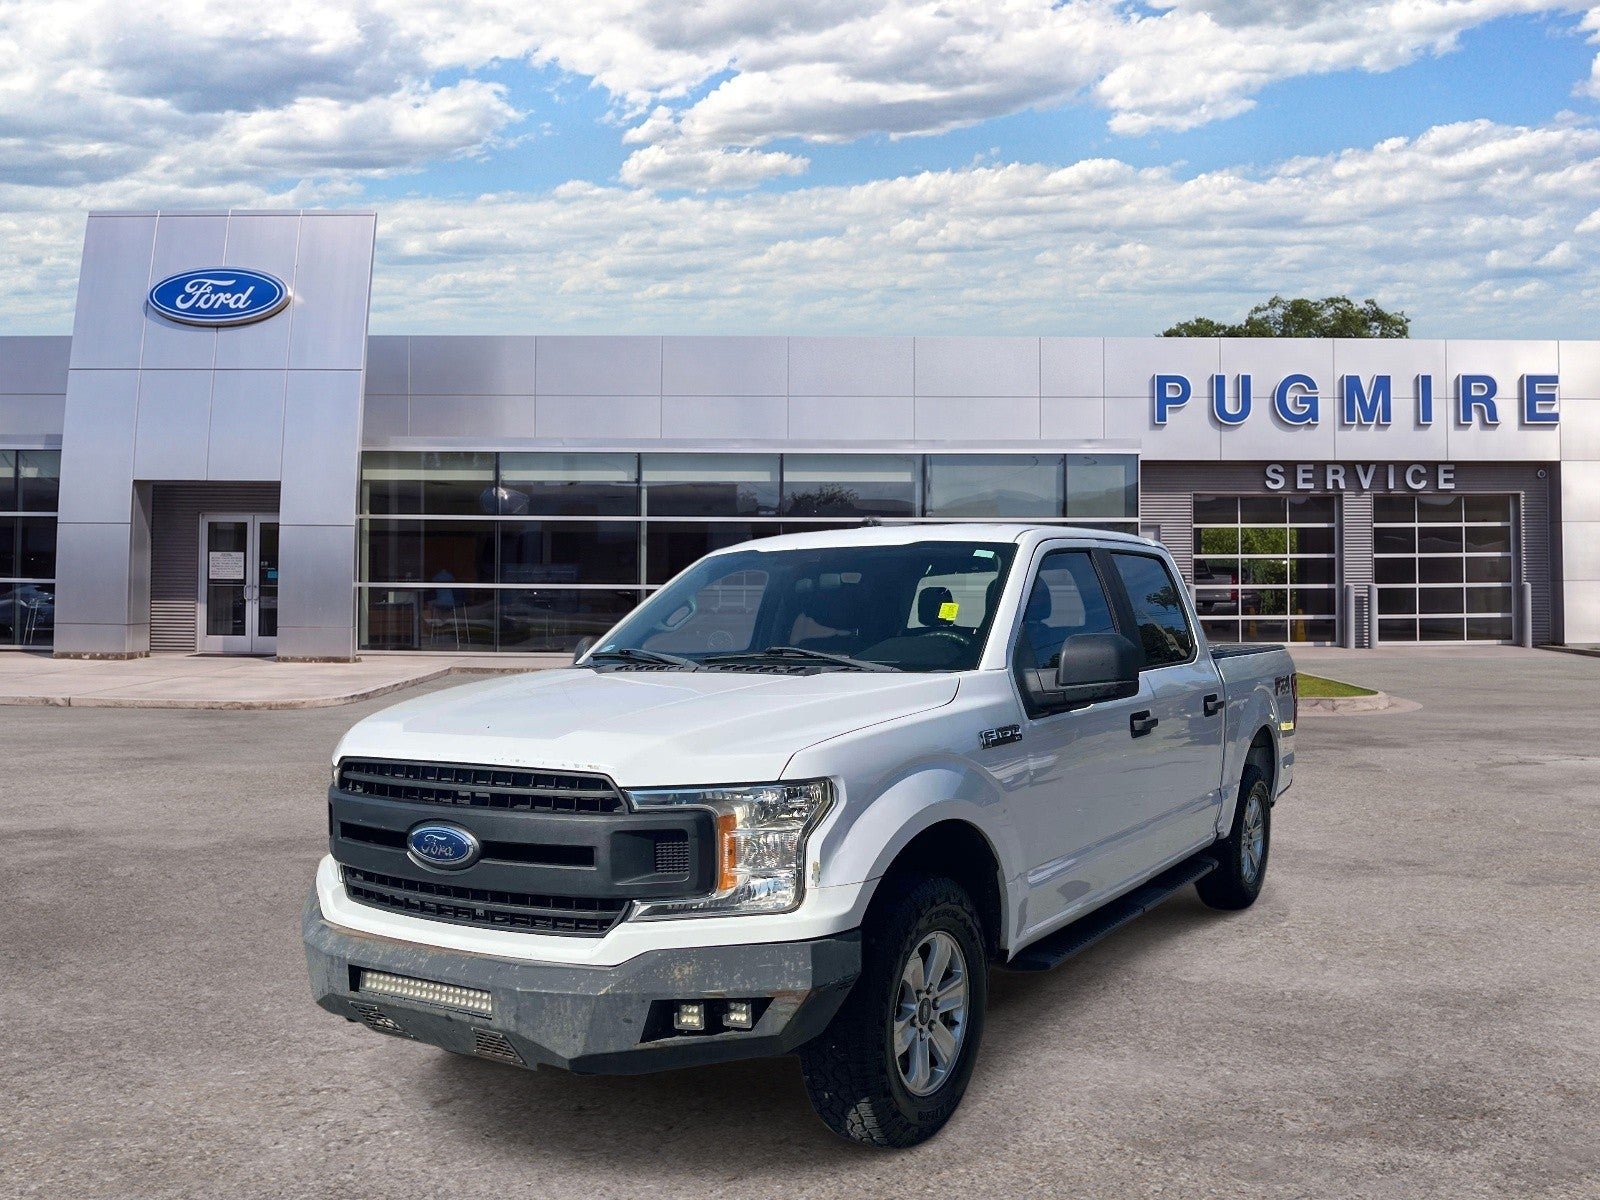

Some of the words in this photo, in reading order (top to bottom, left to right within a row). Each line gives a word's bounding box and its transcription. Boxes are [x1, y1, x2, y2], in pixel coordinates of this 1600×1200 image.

[175, 278, 255, 309] Ford
[1153, 372, 1560, 426] PUGMIRE
[1264, 463, 1456, 491] SERVICE
[421, 834, 455, 857] Ford
